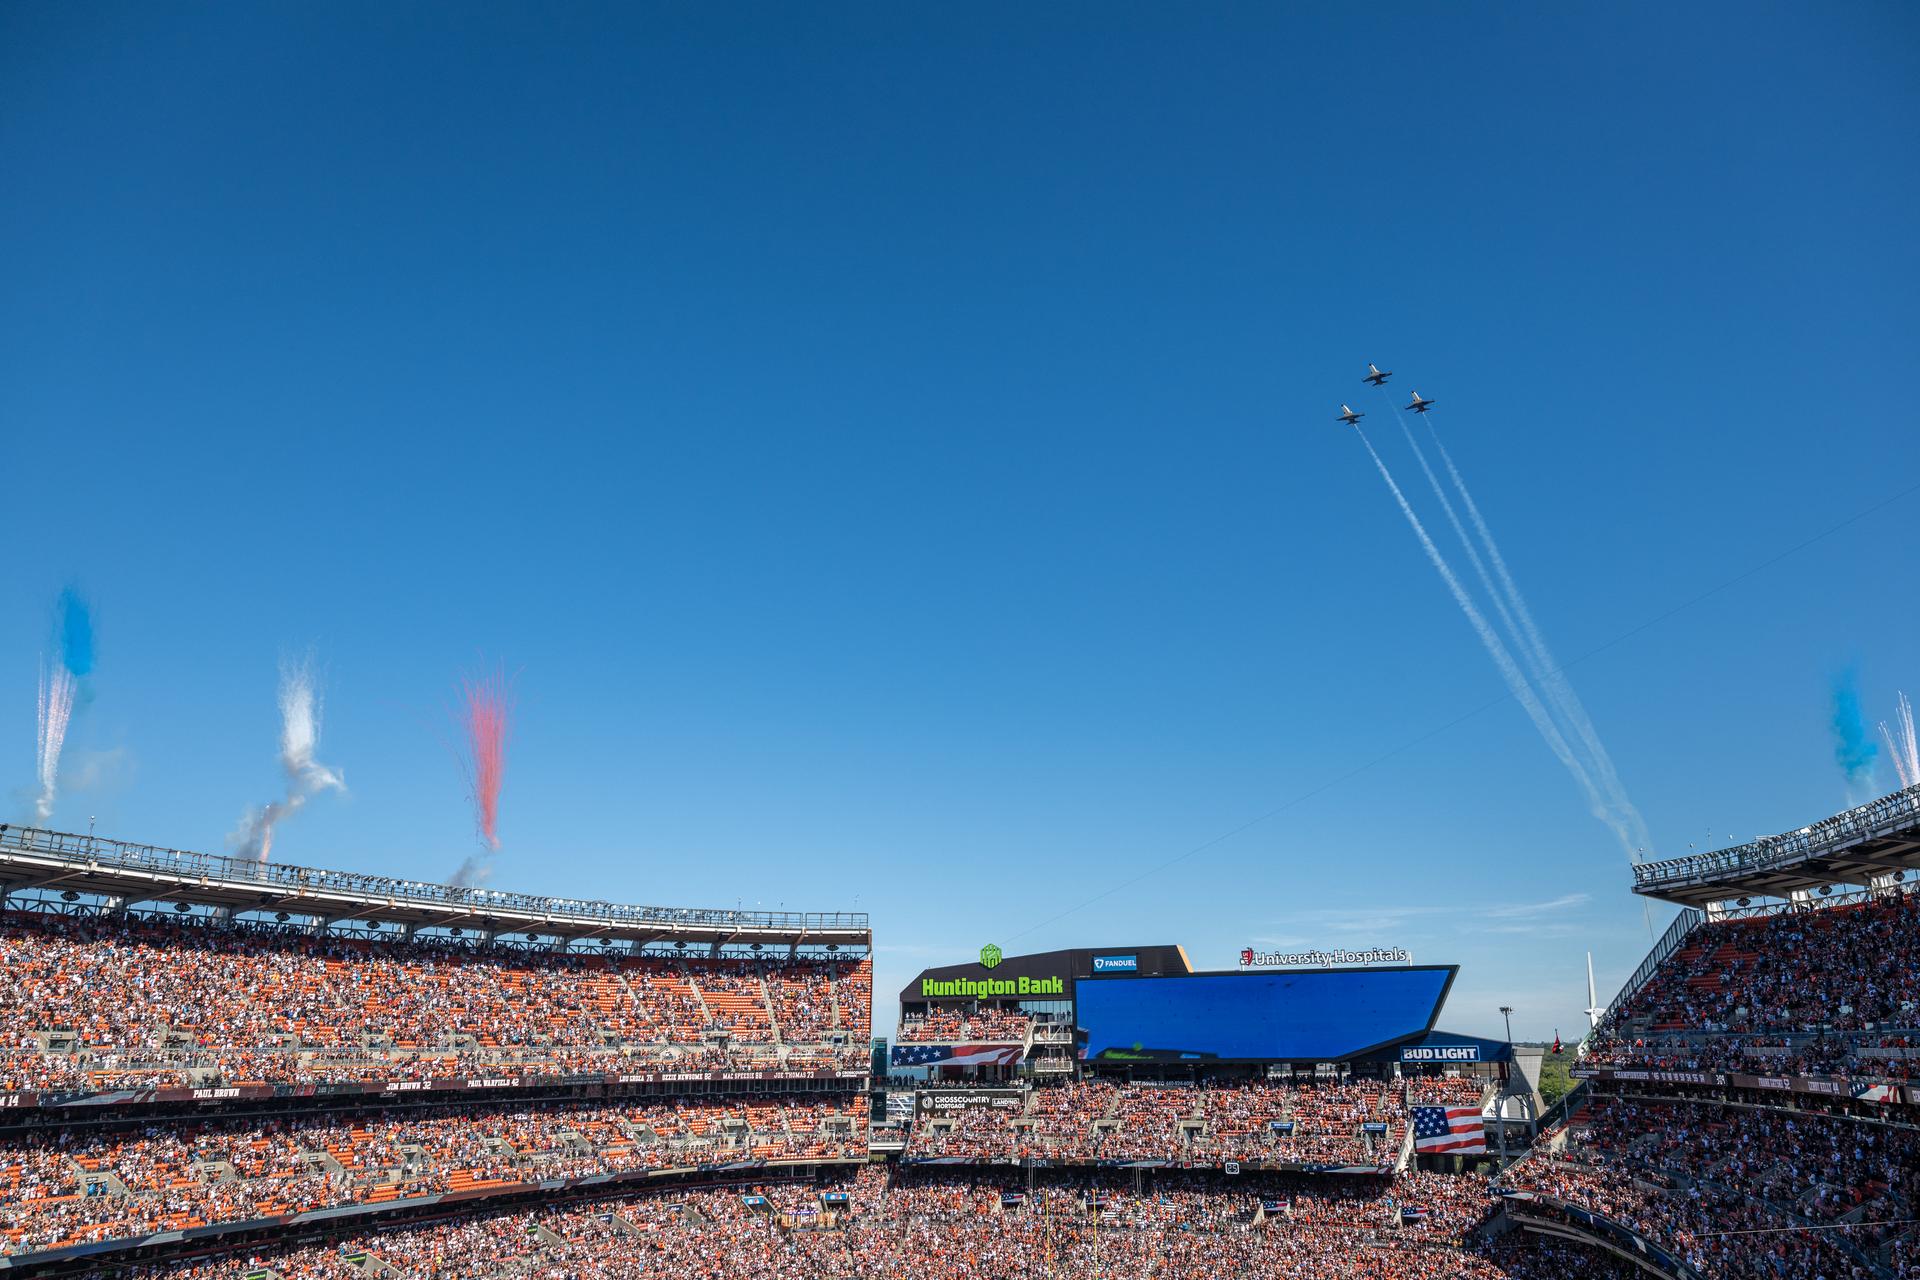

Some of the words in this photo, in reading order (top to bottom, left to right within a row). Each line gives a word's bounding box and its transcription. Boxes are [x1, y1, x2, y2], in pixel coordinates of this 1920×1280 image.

[1255, 950, 1332, 967] University
[1334, 947, 1407, 966] Hospitals
[1104, 959, 1137, 967] FANDUEL
[922, 977, 1016, 999] Huntington
[1018, 976, 1063, 995] Bank
[1403, 1048, 1433, 1059] BUD
[1434, 1048, 1476, 1059] LIGHT
[422, 1081, 432, 1090] 32
[193, 1089, 213, 1098] PAUL
[214, 1088, 240, 1098] BROWN
[7, 1095, 19, 1107] 14
[1228, 1164, 1238, 1173] 25
